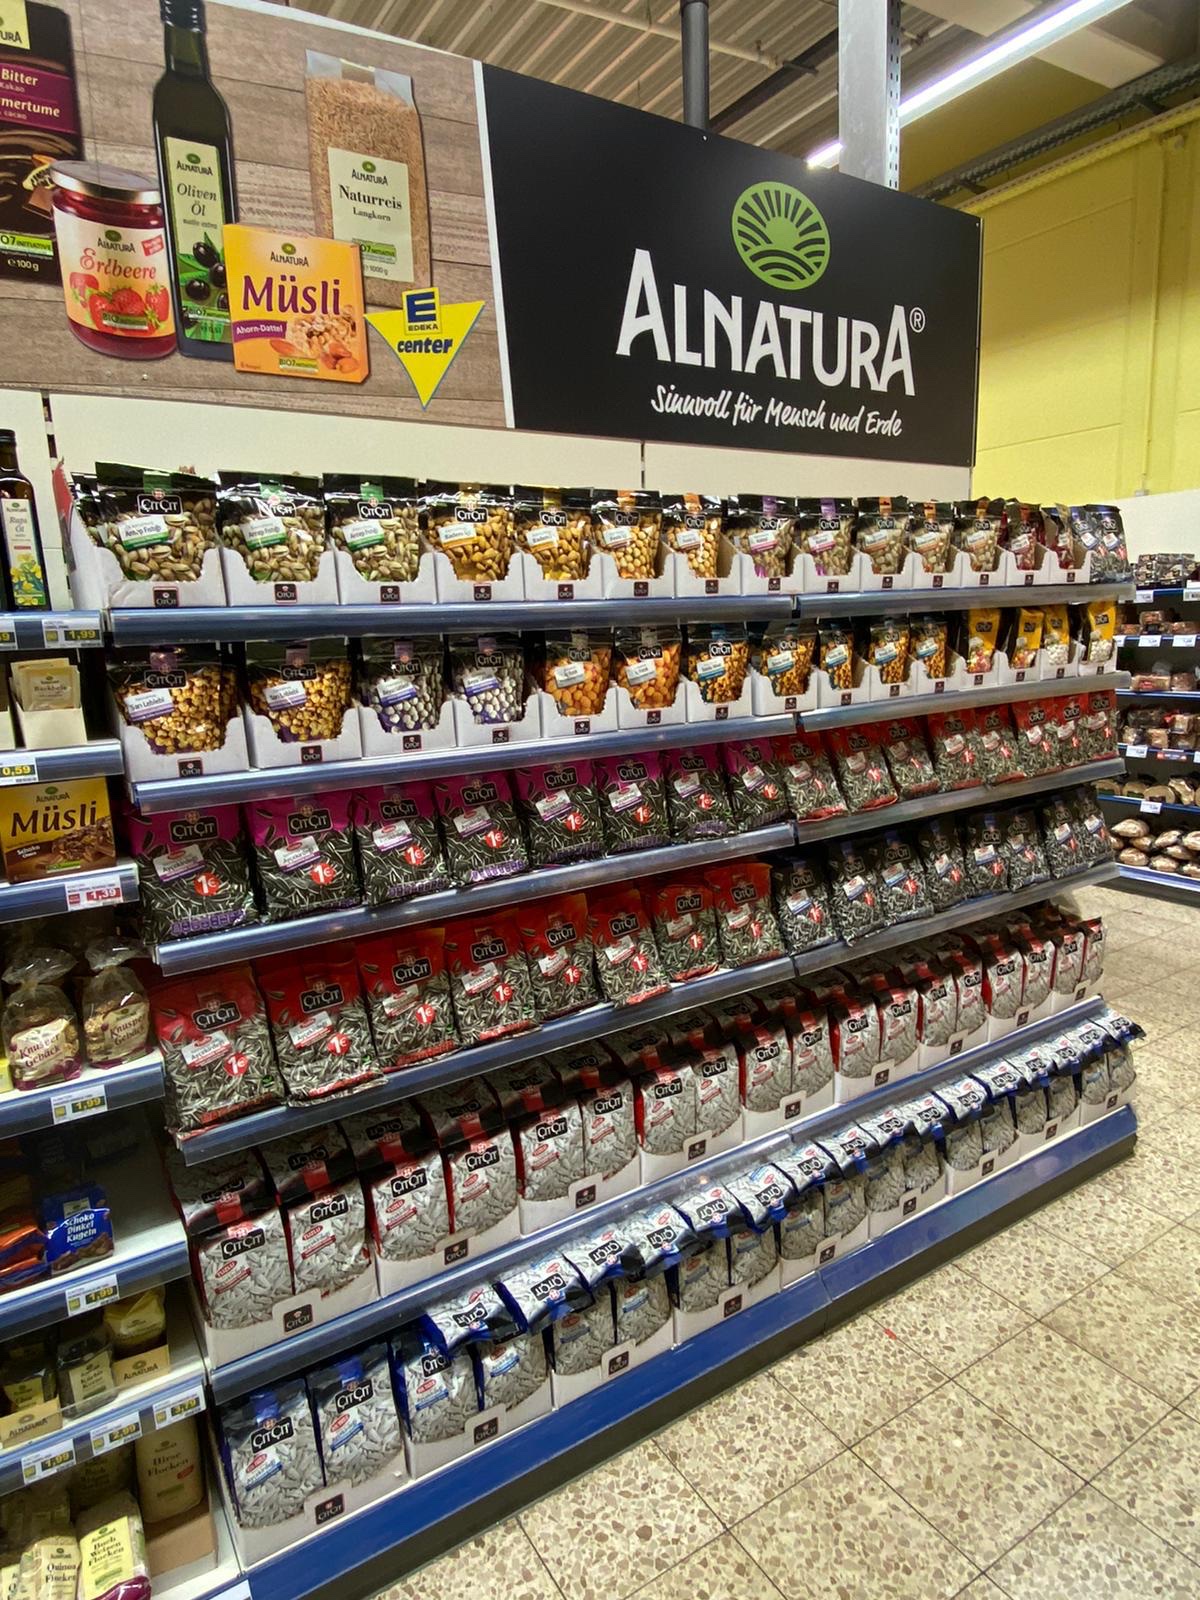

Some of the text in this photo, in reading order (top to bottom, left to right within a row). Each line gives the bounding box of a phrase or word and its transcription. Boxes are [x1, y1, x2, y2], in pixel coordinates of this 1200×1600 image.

[0, 31, 22, 44] URA
[2, 68, 38, 87] Bitter
[1, 98, 61, 119] mertume
[176, 160, 213, 177] ALNATURA
[351, 168, 388, 187] ALNATURA
[176, 182, 217, 202] Oliven
[338, 184, 403, 211] Naturreis
[190, 200, 207, 217] Öl
[352, 207, 392, 223] Langkorn
[98, 238, 136, 254] ALNATURA
[79, 248, 157, 281] Erdbeere
[270, 251, 309, 268] ALNATURA
[242, 274, 341, 316] Müsli
[405, 291, 437, 323] E
[236, 323, 284, 337] Ahorn-Dattel
[407, 322, 440, 332] EDEKA
[396, 336, 454, 356] center
[651, 384, 903, 438] Sinnvoll für Mensch und Erde
[11, 800, 98, 838] Müsli
[408, 846, 424, 864] 1€
[315, 864, 332, 884] 1€
[197, 874, 216, 894] 1€
[495, 984, 511, 1003] 1€
[418, 1005, 434, 1025] 1€
[331, 1036, 348, 1055] 1€
[229, 1054, 247, 1075] 1€
[65, 1212, 96, 1228] Schoko
[67, 1221, 95, 1236] Dinkel
[66, 1228, 97, 1245] Kugeln
